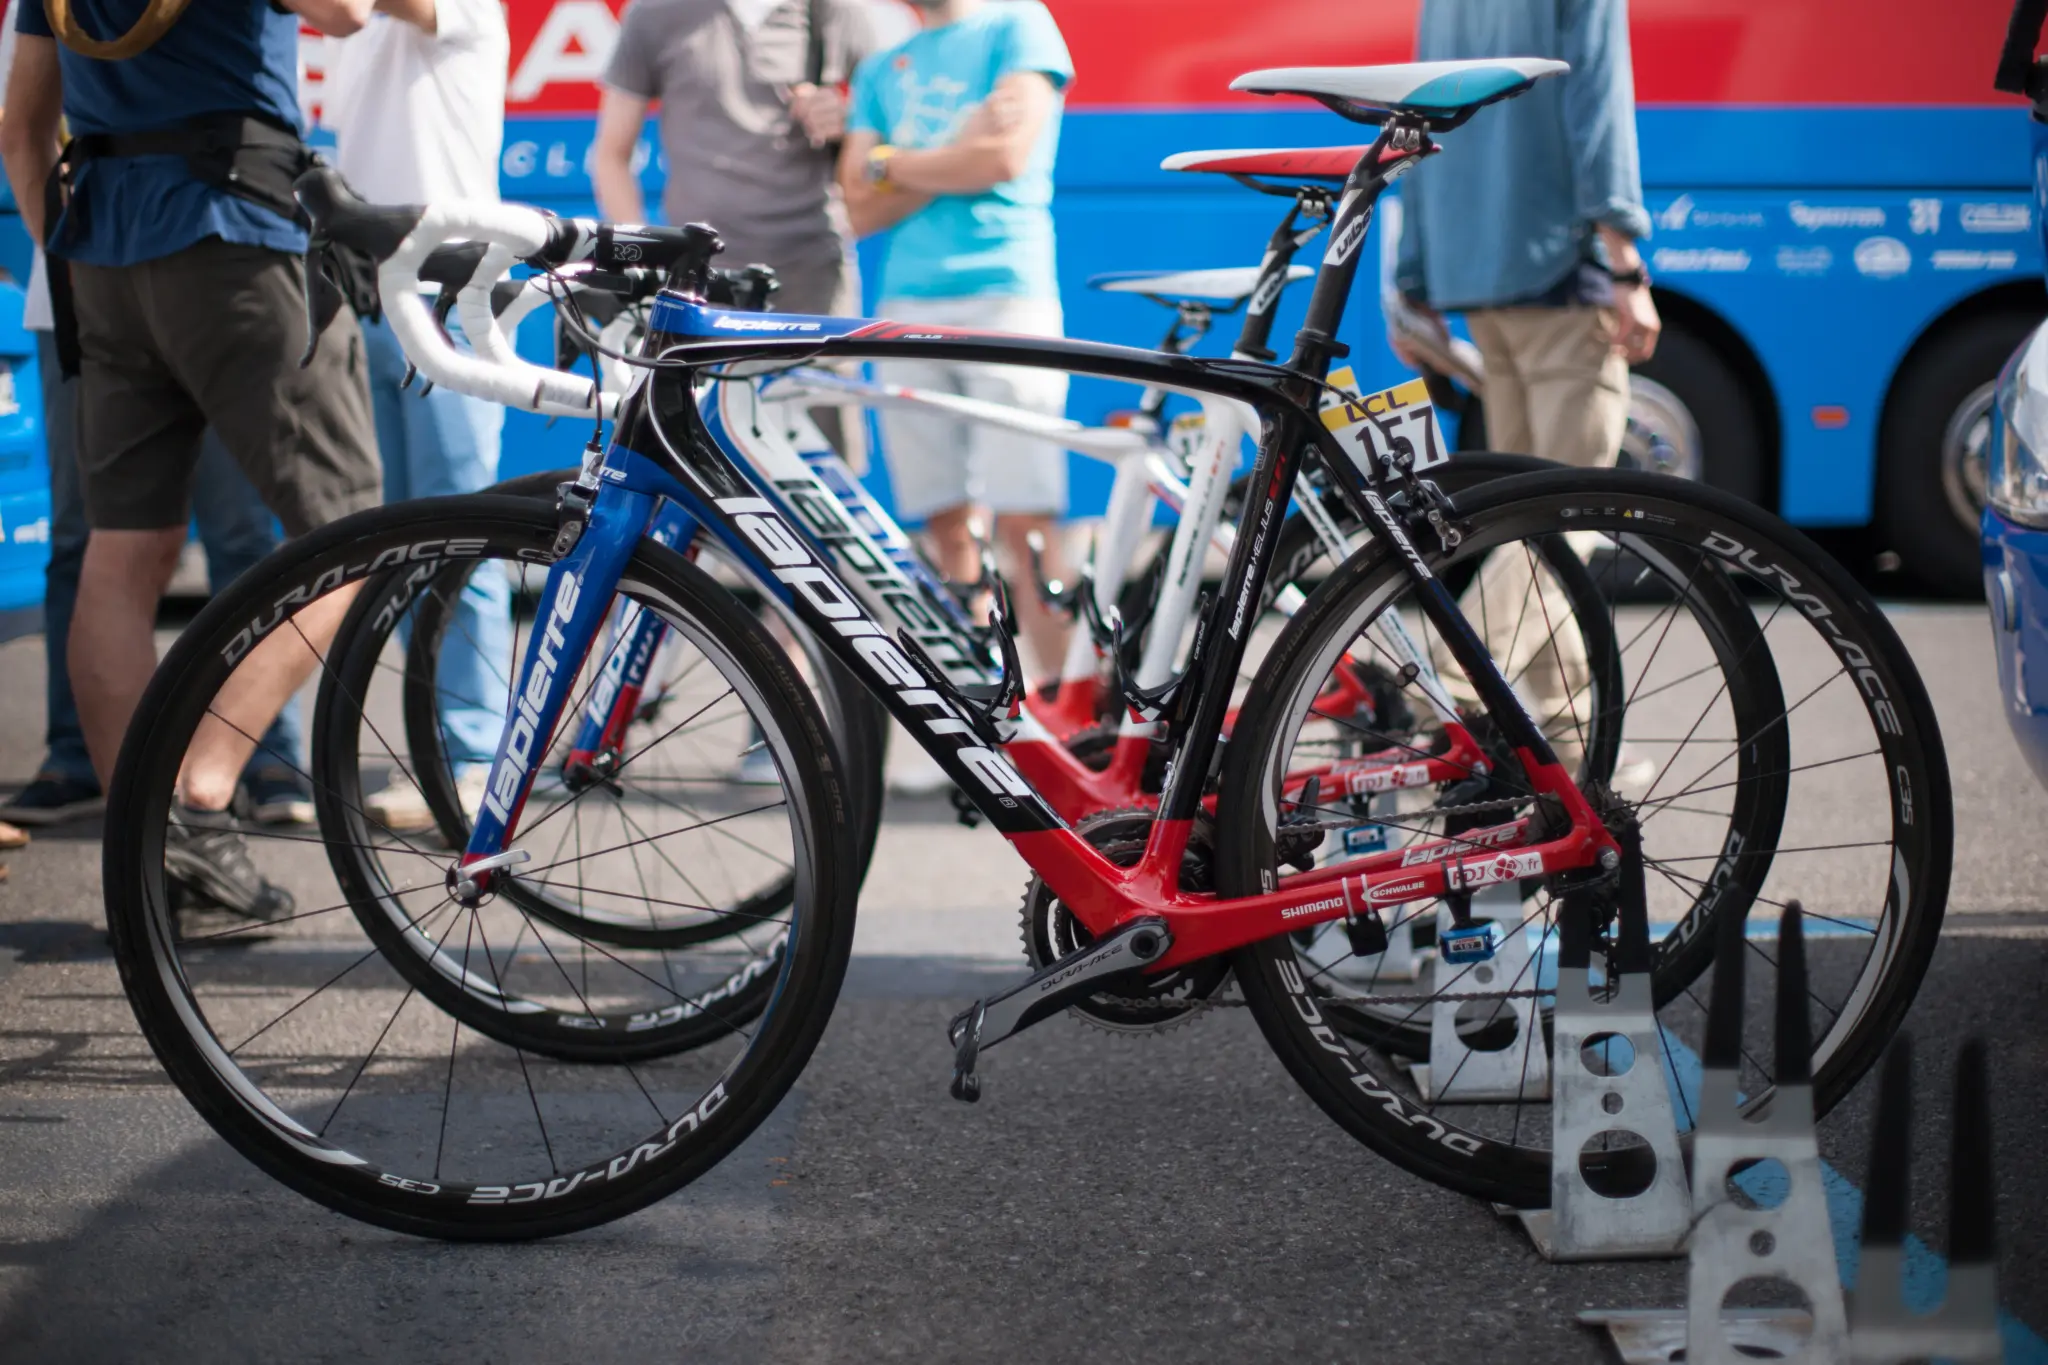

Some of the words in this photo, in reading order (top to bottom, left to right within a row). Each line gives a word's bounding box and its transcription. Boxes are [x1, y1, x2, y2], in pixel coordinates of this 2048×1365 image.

[712, 314, 821, 332] lapierre
[1344, 390, 1408, 424] LCL
[1355, 404, 1440, 482] 157
[1228, 564, 1256, 641] lapierre
[1251, 498, 1274, 565] XELIUS
[1360, 489, 1433, 579] lapierre
[220, 538, 489, 668] DURA-ACE
[1701, 530, 1903, 737] DURA-ACE
[712, 497, 1032, 797] lapierre
[484, 571, 579, 828] lapierre
[1896, 764, 1914, 827] C35
[1400, 824, 1519, 868] lapierre
[1452, 866, 1486, 886] FDJ
[1281, 895, 1345, 919] SHIMANO
[1372, 880, 1425, 898] SCHWALBE
[1041, 943, 1124, 991] DURA-ACE
[1275, 958, 1484, 1158] DURA-ACE
[467, 1082, 729, 1204] DURA-ACE
[377, 1173, 440, 1195] C35
